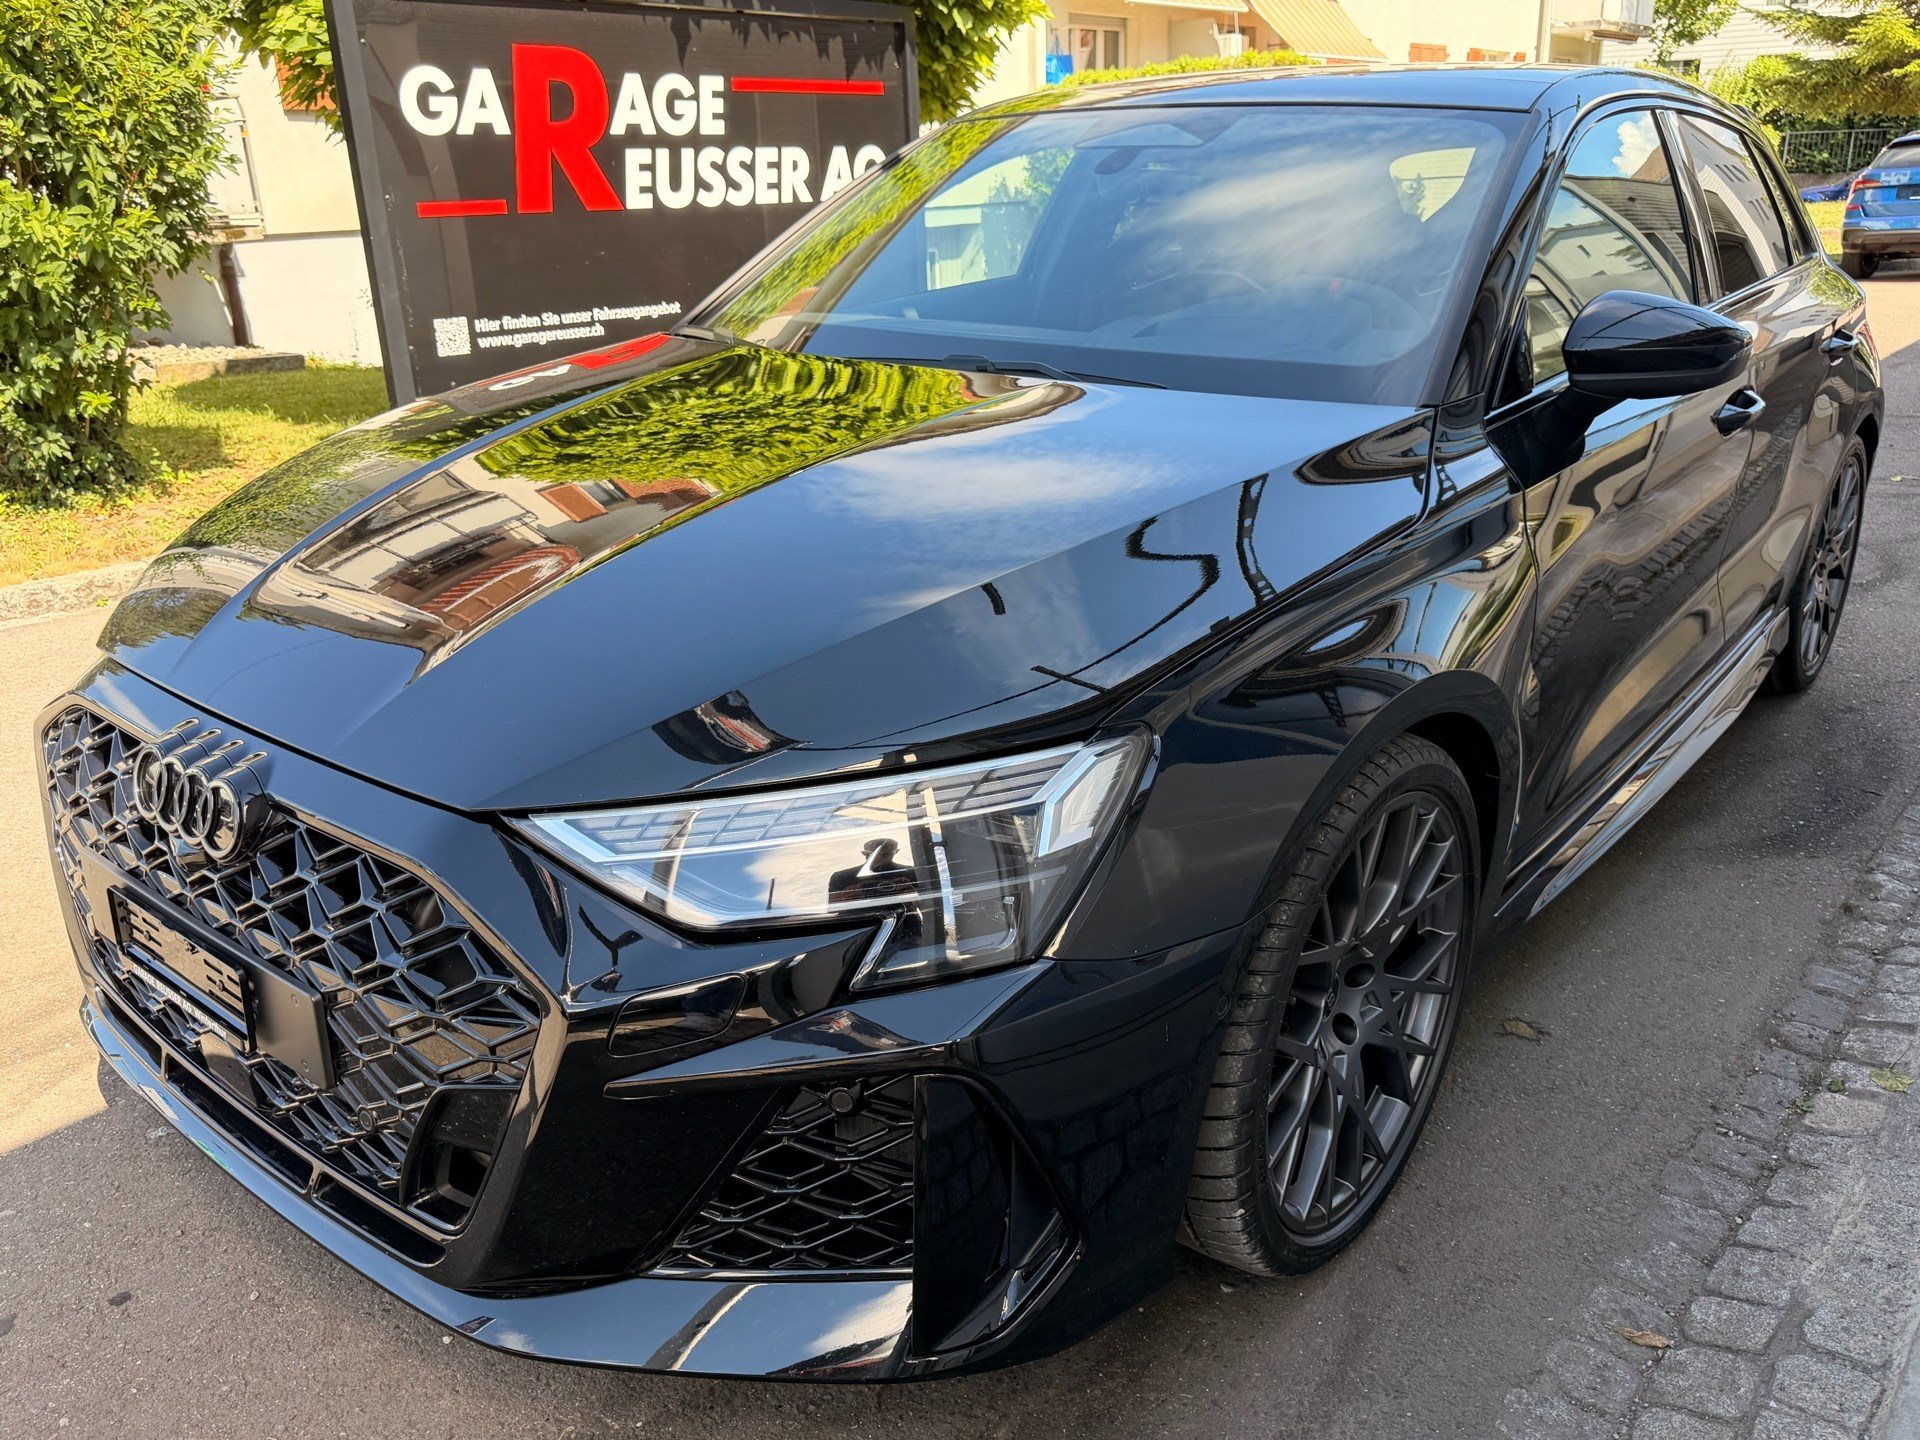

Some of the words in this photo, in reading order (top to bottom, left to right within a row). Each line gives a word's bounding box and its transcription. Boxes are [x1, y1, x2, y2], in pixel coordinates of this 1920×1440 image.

[400, 43, 725, 214] GARAGE
[474, 318, 501, 333] Hier
[502, 313, 541, 330] finden
[541, 311, 560, 326] Sie
[560, 311, 592, 325] unser
[592, 301, 681, 320] Fahrzeugangebot
[477, 322, 605, 348] www.garagereusser.ch
